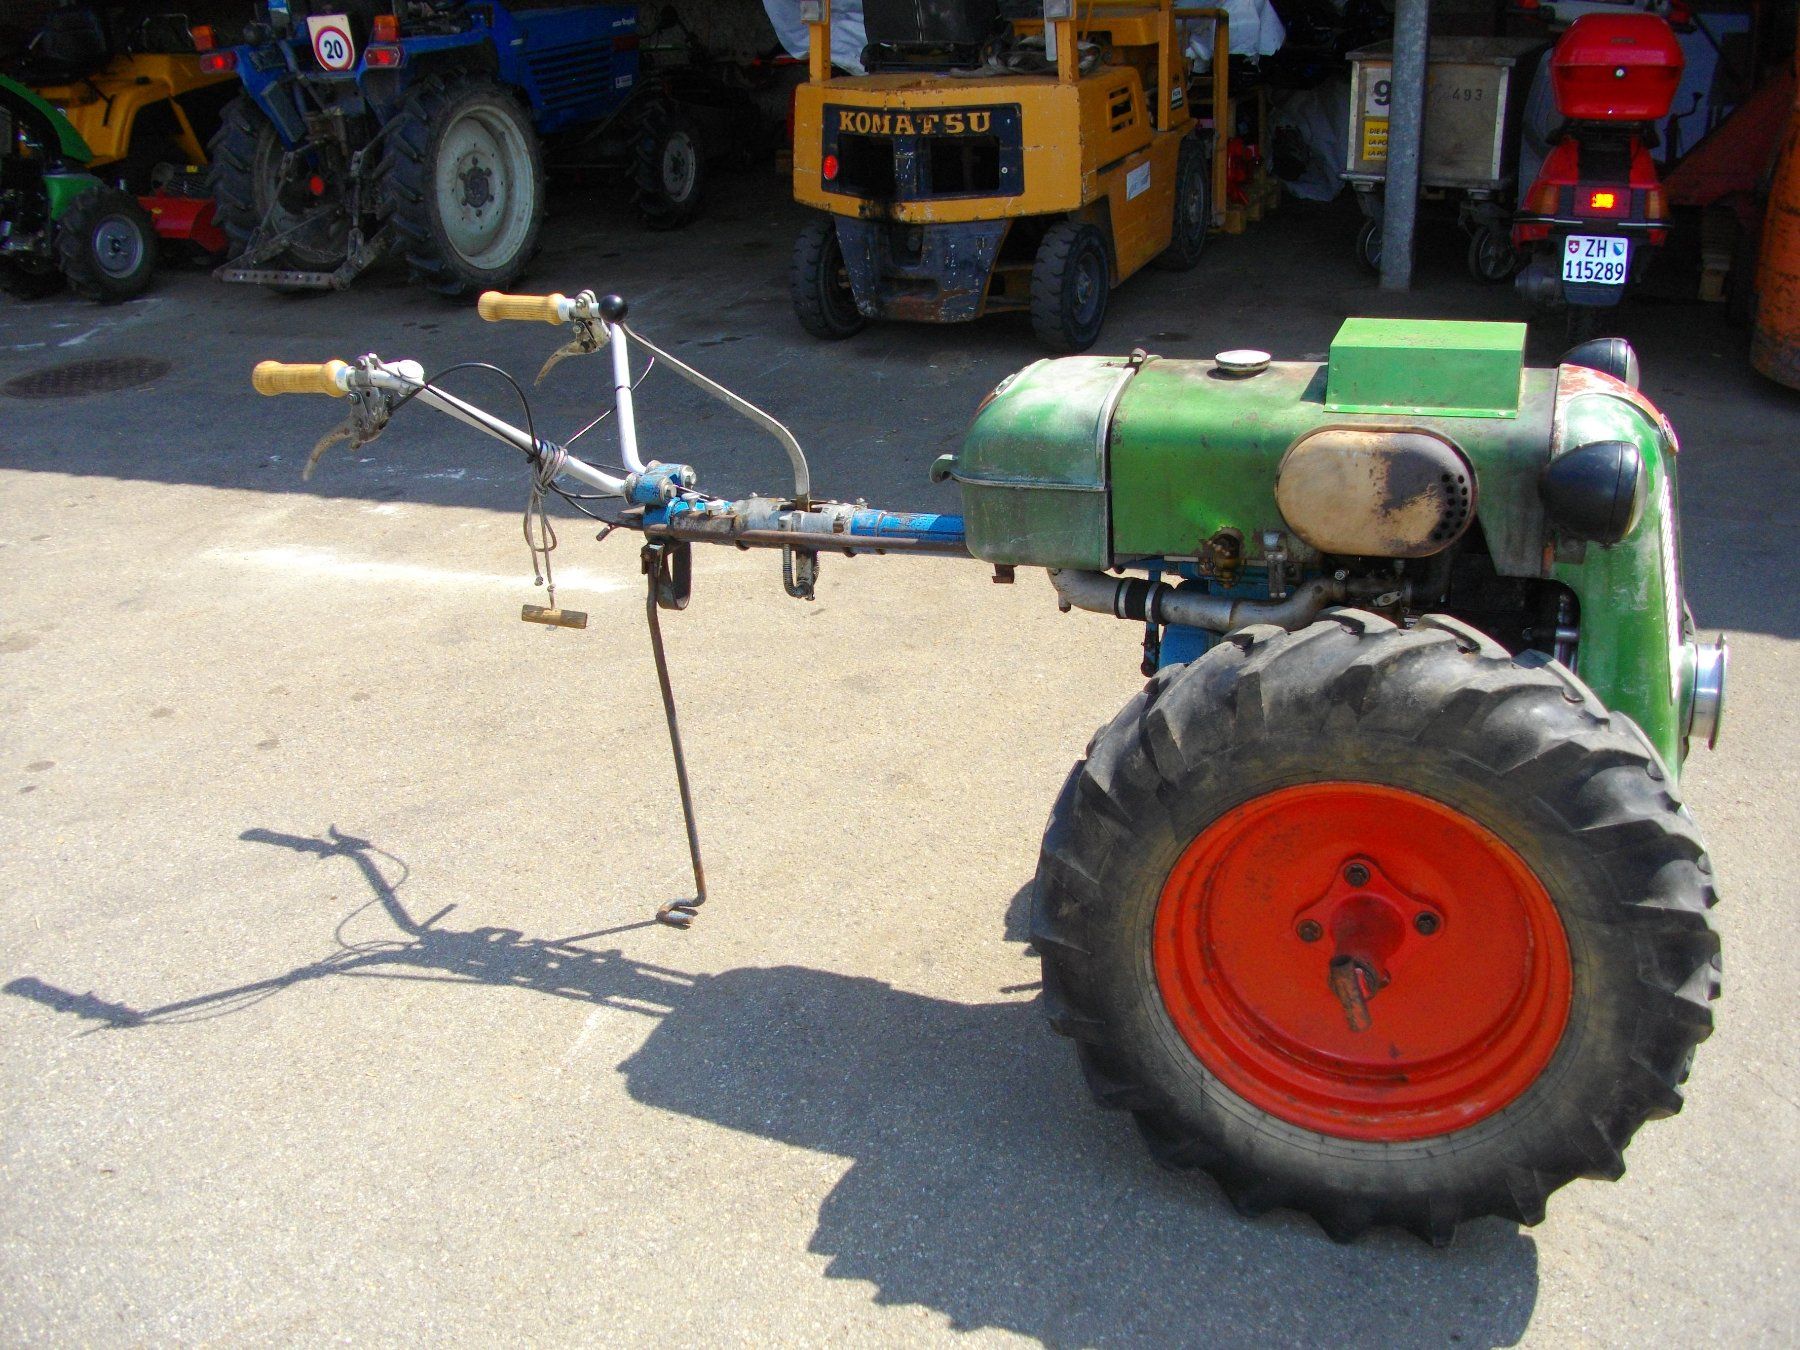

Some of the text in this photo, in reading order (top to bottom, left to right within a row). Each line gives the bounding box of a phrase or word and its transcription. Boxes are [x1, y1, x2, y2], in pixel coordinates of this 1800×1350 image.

[324, 40, 343, 59] 20
[839, 111, 991, 135] KOMATSU
[1585, 239, 1607, 258] ZH
[1565, 260, 1624, 281] 115289
